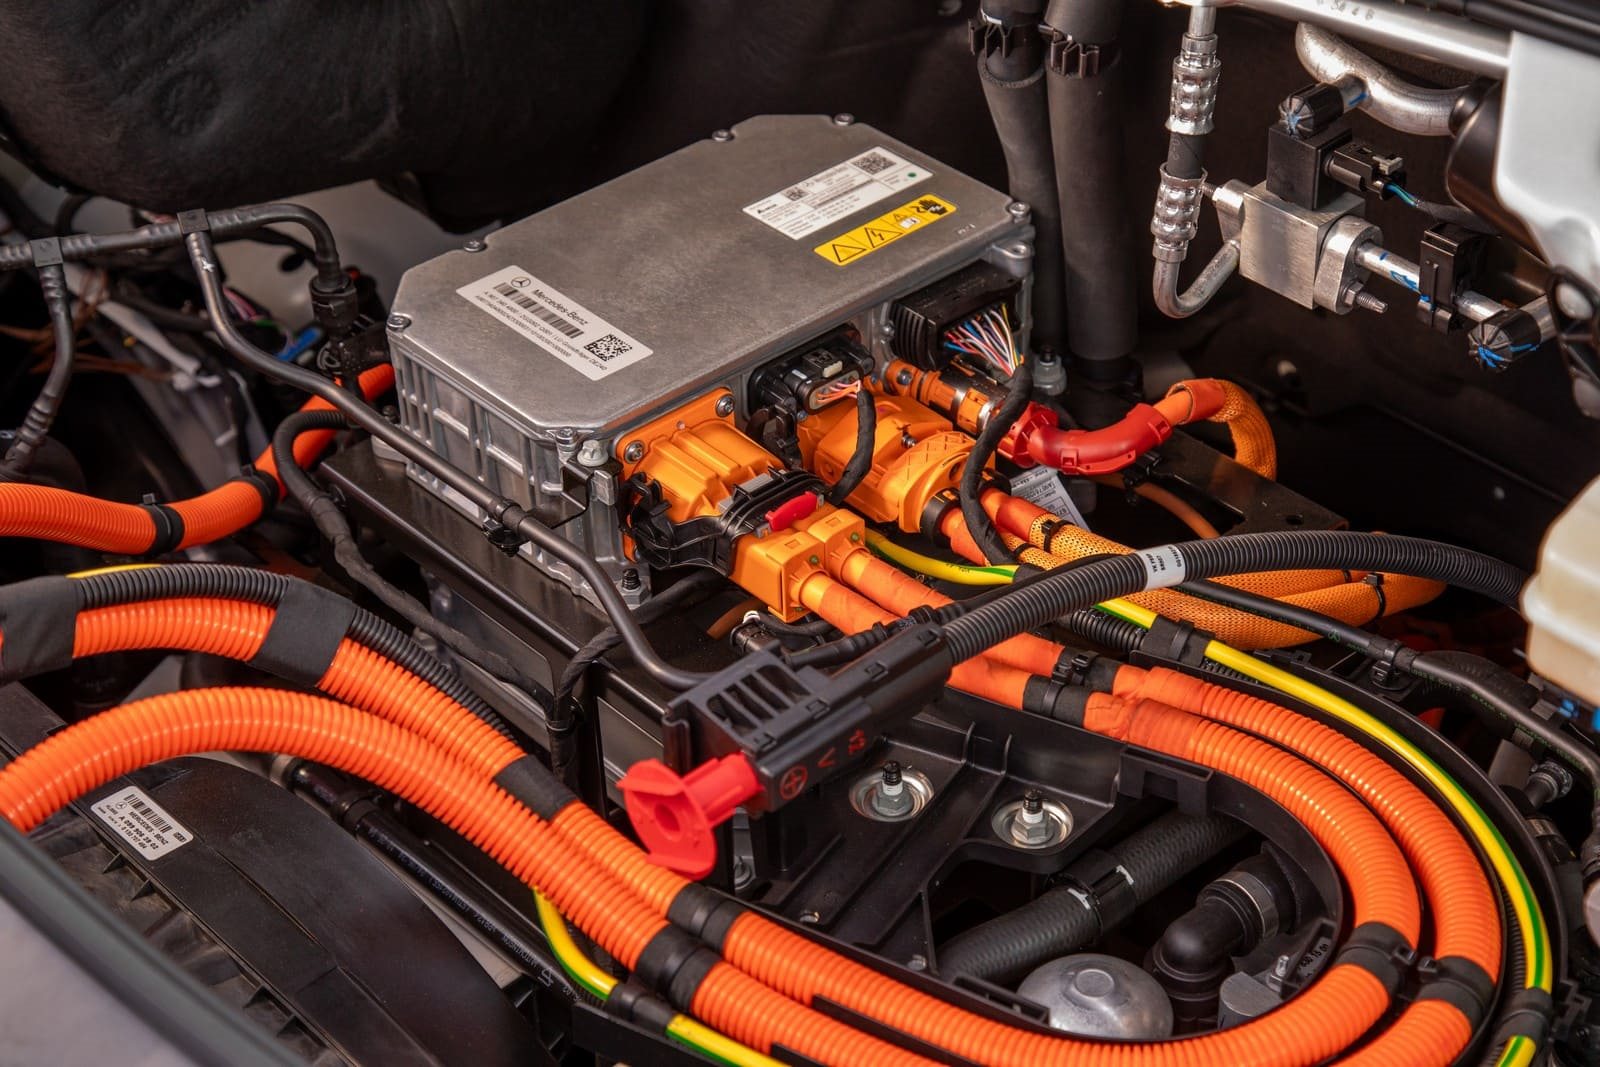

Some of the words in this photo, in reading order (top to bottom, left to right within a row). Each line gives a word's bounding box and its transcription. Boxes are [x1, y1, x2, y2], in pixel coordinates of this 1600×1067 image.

[532, 289, 589, 325] Mercedes-Benz
[128, 811, 154, 833] MERCEDES
[154, 833, 168, 845] BENZ
